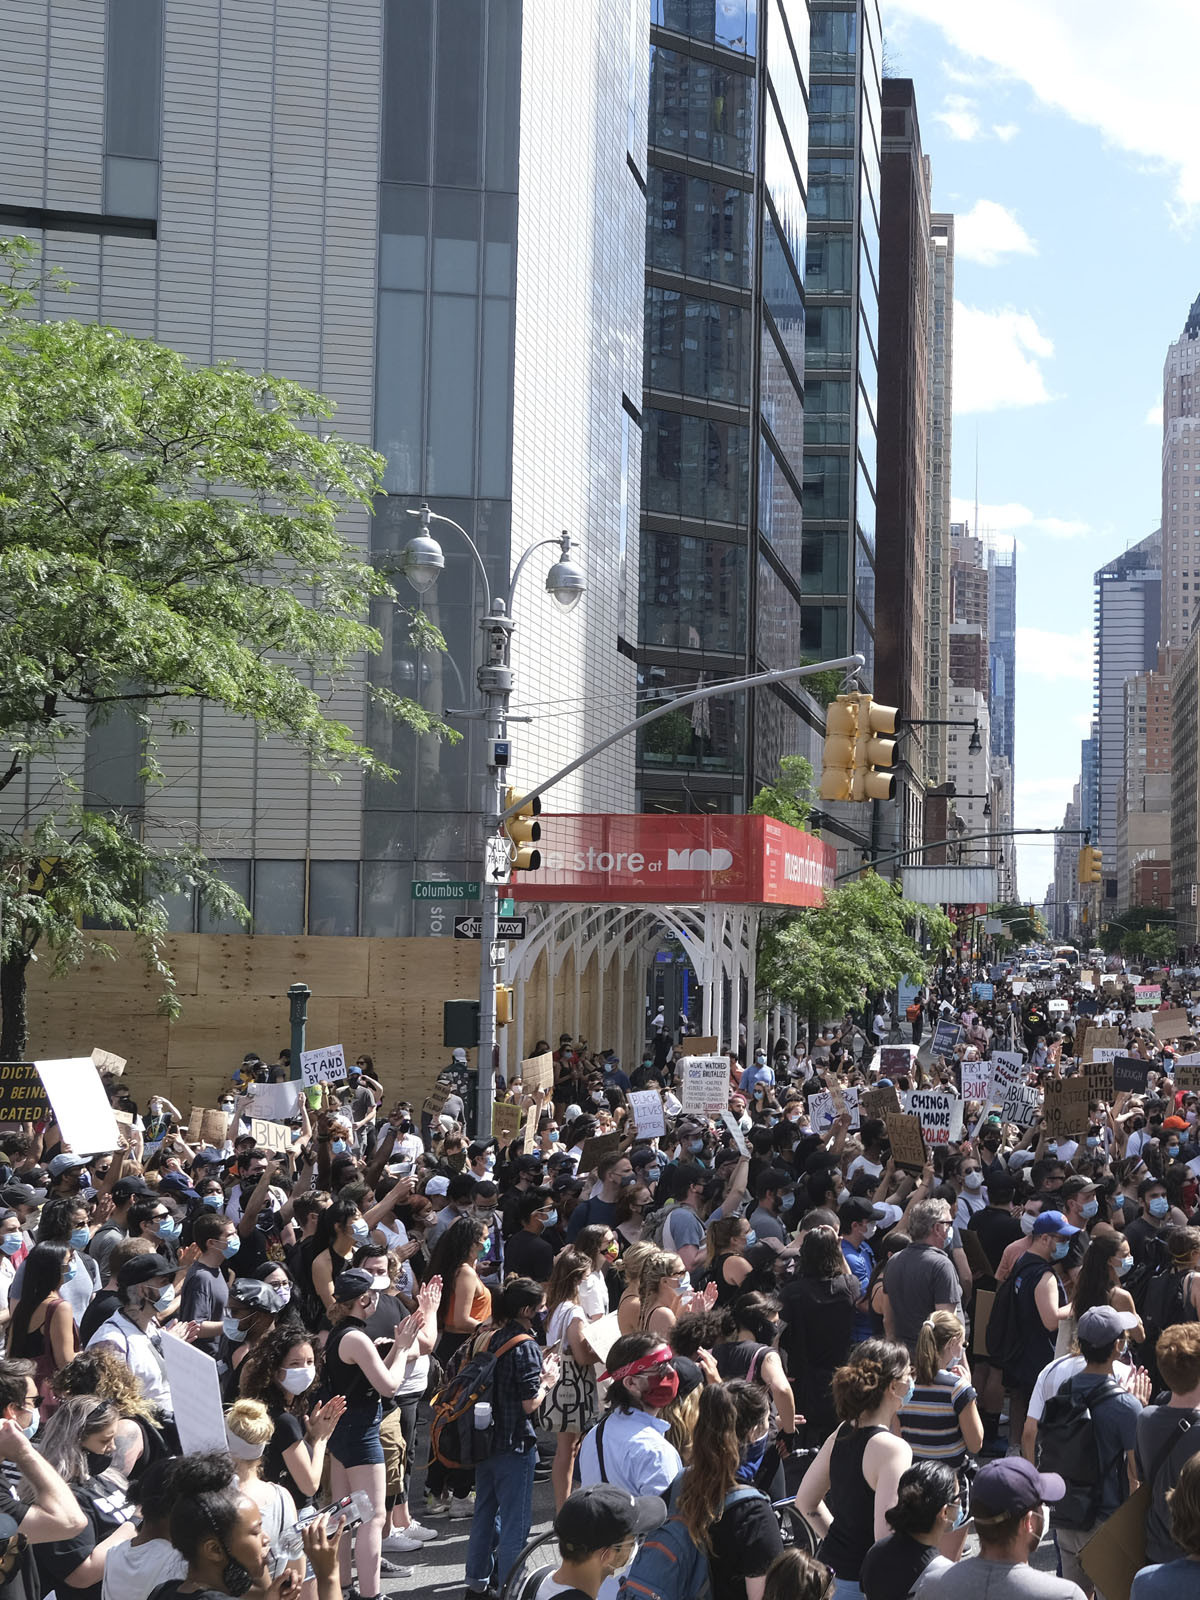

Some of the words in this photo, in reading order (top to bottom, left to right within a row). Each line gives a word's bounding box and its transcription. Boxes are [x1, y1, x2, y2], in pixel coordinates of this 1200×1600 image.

[574, 847, 645, 872] store
[648, 859, 663, 872] at
[415, 883, 464, 897] Columbus
[468, 884, 477, 892] Cir
[461, 923, 481, 933] ONE
[498, 923, 520, 933] WAY
[304, 1057, 343, 1074] STAND
[309, 1074, 319, 1085] BY
[325, 1068, 346, 1080] YOU!
[1116, 1068, 1143, 1081] ENOUGH
[1046, 1081, 1063, 1094] NO
[1088, 1076, 1113, 1088] LIVES
[1177, 1078, 1192, 1086] THE
[10, 1086, 46, 1099] BEING
[963, 1081, 987, 1099] BOUR
[1006, 1085, 1039, 1108] ABOLISH
[631, 1094, 656, 1105] BLACK
[911, 1094, 949, 1110] CHINGA
[635, 1104, 662, 1118] LIVES
[1001, 1101, 1036, 1127] POLICE
[1046, 1108, 1062, 1122] NO
[922, 1111, 950, 1126] MADRE
[254, 1121, 288, 1148] BLM
